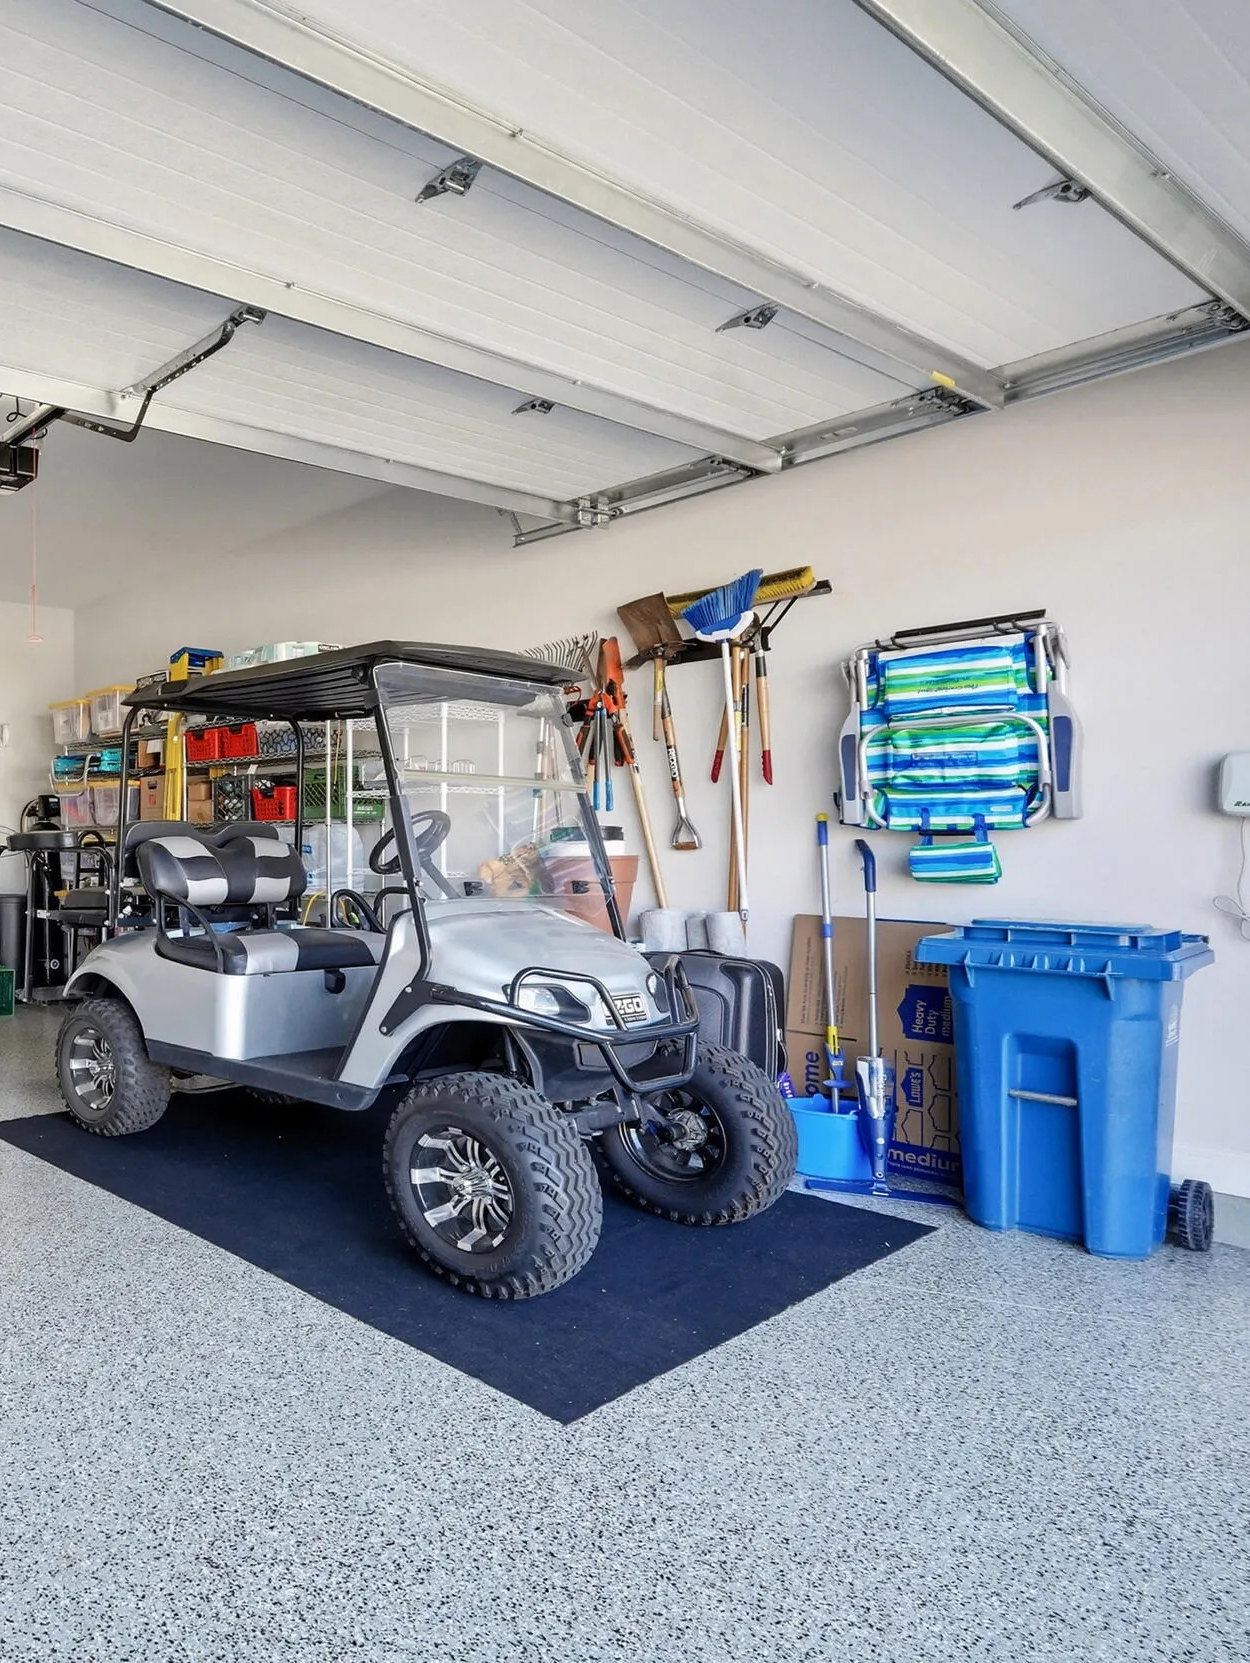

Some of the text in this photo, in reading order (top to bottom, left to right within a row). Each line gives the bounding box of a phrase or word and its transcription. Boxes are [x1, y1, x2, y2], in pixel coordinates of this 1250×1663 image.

[911, 999, 927, 1034] Heavy
[924, 1009, 940, 1035] Duty
[805, 1051, 820, 1096] ome
